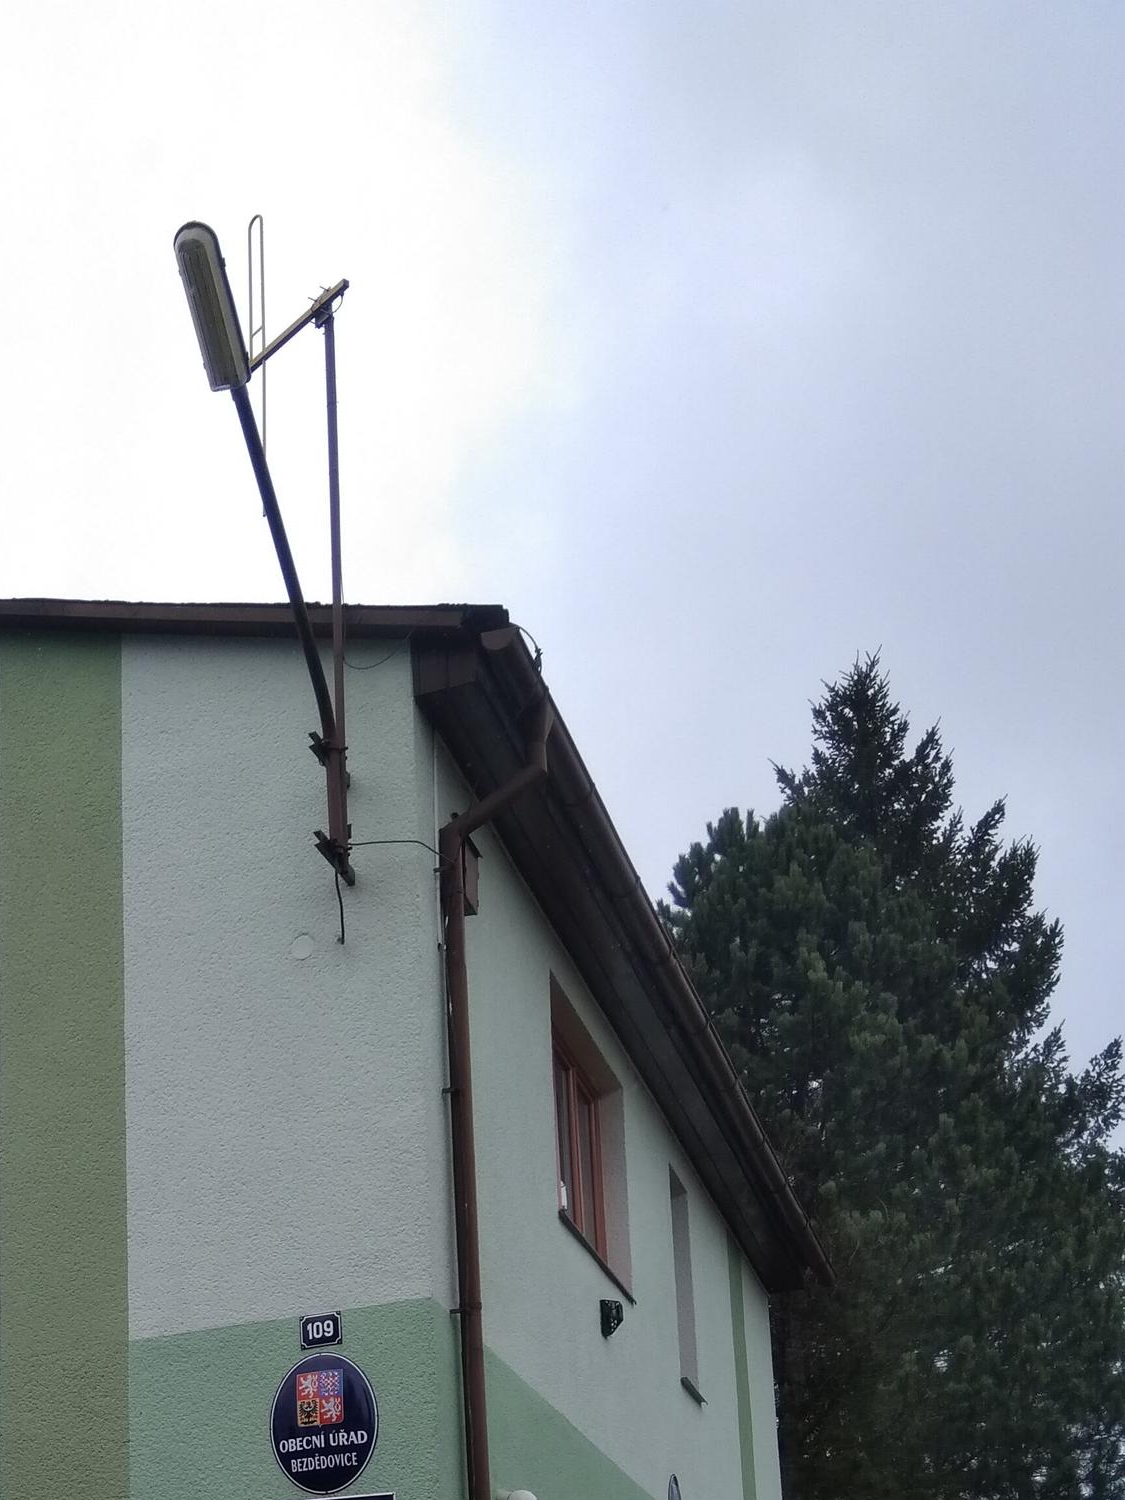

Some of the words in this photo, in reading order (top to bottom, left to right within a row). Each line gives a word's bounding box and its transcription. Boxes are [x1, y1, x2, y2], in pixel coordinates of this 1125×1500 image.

[306, 1320, 334, 1340] 109
[279, 1431, 326, 1453] OBECNÍ
[329, 1429, 368, 1446] ÚŘAD
[291, 1452, 358, 1473] BEZDĚDOVICE
